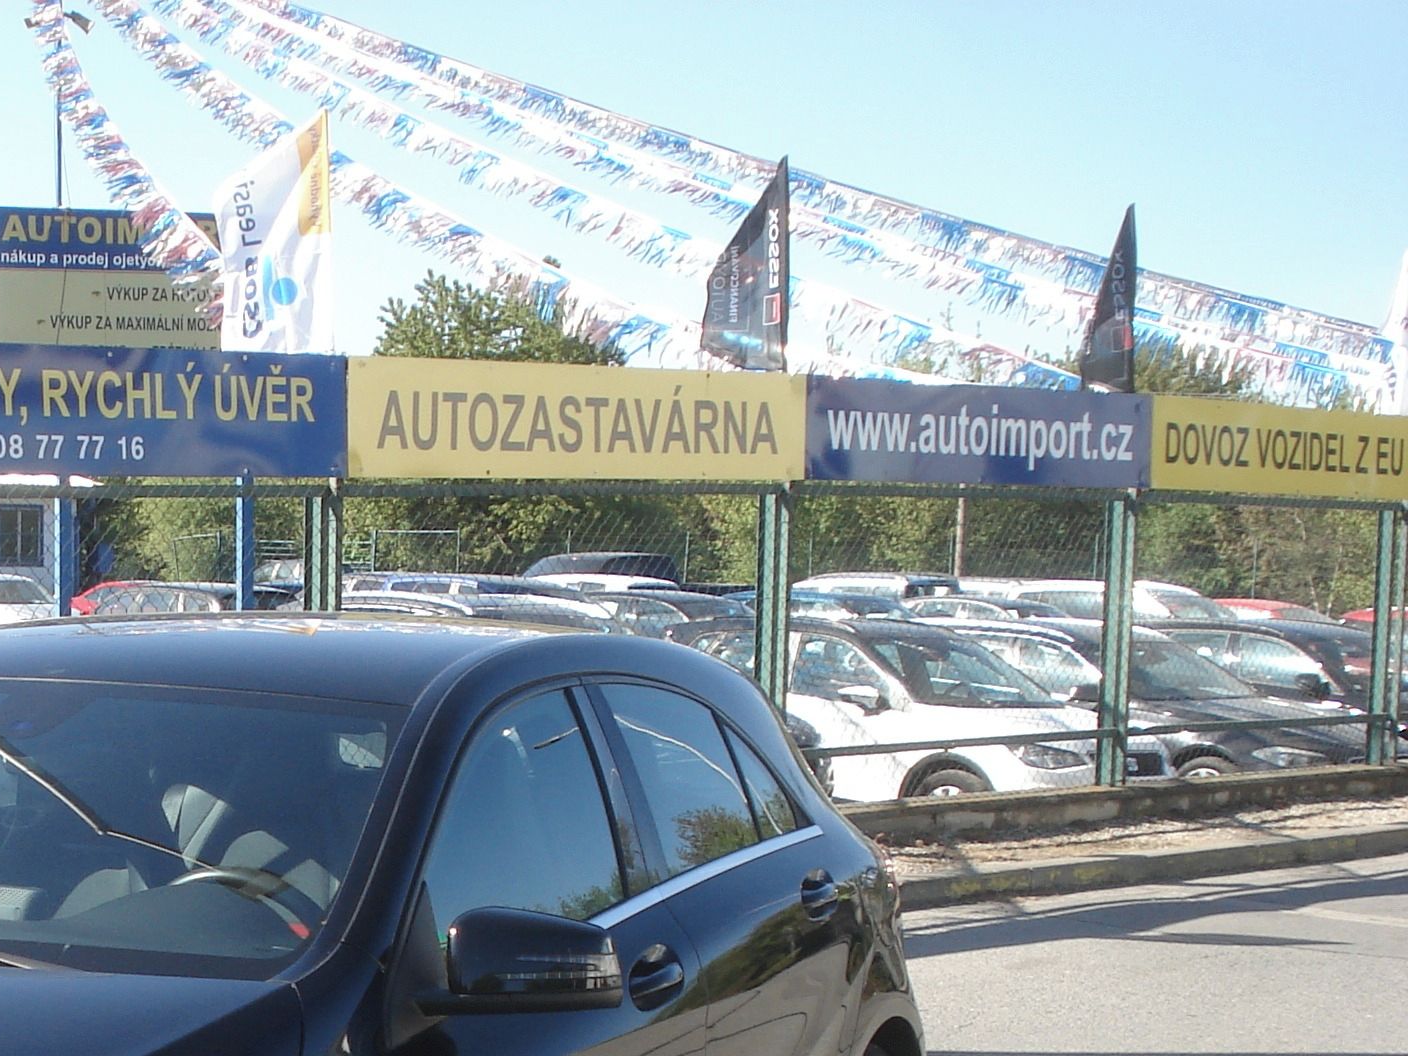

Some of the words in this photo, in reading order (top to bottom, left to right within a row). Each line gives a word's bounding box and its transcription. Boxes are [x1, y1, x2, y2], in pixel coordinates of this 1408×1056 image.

[0, 249, 45, 267] nákup
[50, 253, 58, 263] a
[63, 252, 108, 269] prodej
[107, 283, 149, 301] VÝKUP
[152, 287, 168, 302] ZA
[50, 312, 92, 330] VÝKUP
[96, 315, 112, 330] ZA
[116, 313, 184, 331] MAXIMÁLNÍ
[42, 362, 202, 420] RYCHLÝ
[214, 363, 316, 422] ÚVĚR
[377, 385, 779, 455] AUTOZASTAVÁRNA
[827, 404, 1134, 470] www.autoimport.cz
[35, 434, 64, 460] 77
[77, 435, 105, 460] 77
[117, 436, 145, 460] 16
[1165, 422, 1251, 467] DOVOZ
[1257, 428, 1351, 473] VOZIDEL
[1355, 435, 1370, 474] Z
[1376, 436, 1405, 476] EU
